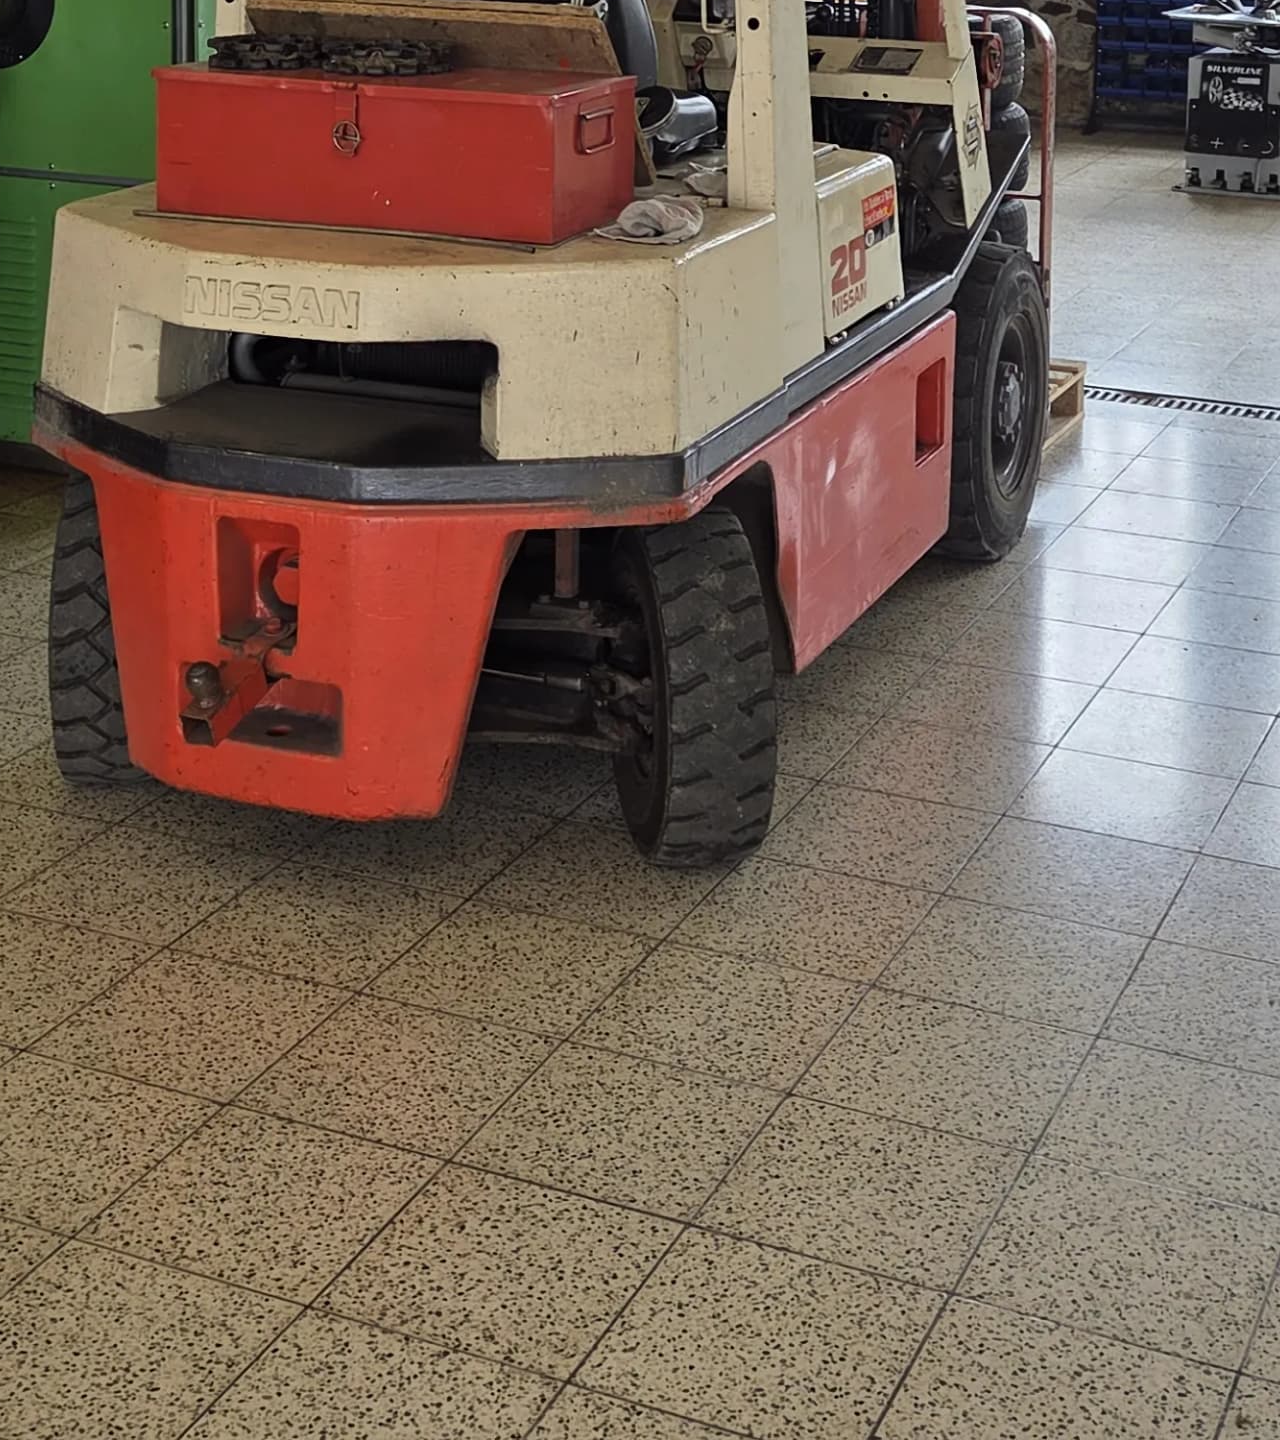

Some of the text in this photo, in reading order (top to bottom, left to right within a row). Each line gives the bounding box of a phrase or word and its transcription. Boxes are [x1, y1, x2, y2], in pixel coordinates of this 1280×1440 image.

[830, 235, 866, 297] 20
[184, 275, 361, 330] NISSAN
[832, 281, 868, 319] NISSAN
